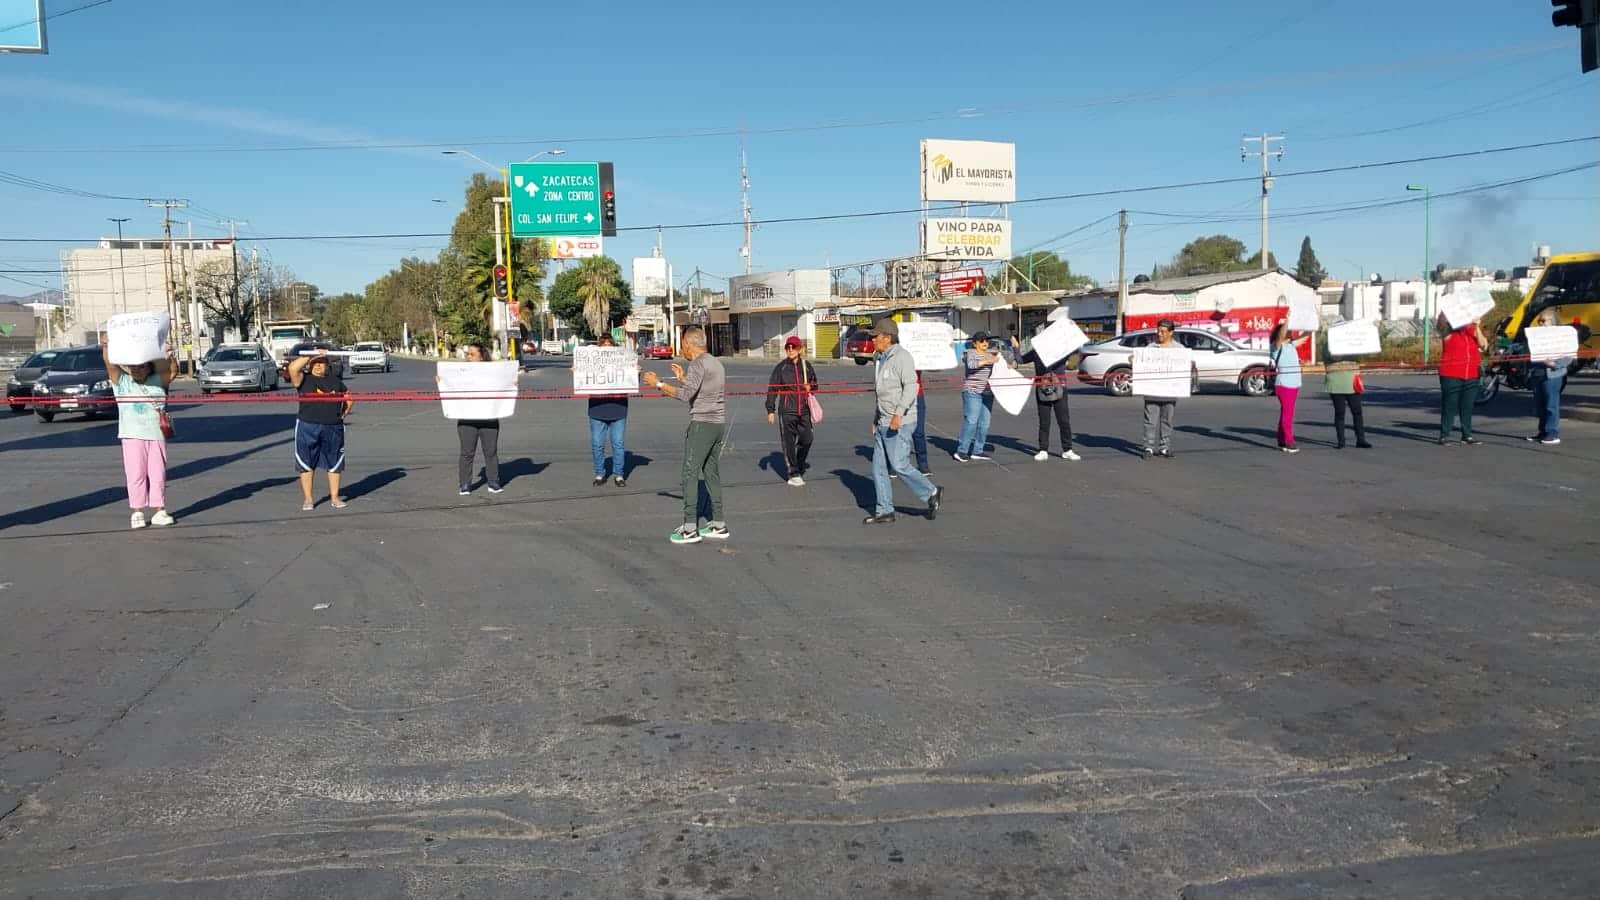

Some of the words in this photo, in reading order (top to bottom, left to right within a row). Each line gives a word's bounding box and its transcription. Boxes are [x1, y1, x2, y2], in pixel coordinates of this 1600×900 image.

[955, 168, 965, 178] EL
[967, 168, 1013, 179] MAYORISTA
[542, 176, 595, 186] ZACATECAS
[543, 191, 563, 201] ZONA
[567, 191, 594, 201] CENTRO
[518, 213, 534, 223] COL.
[537, 213, 552, 223] SAN
[555, 213, 579, 223] FELIPE
[936, 221, 968, 232] VINO
[970, 222, 1003, 233] PARA
[937, 234, 1002, 245] CELEBRAR
[945, 246, 961, 256] LA
[964, 246, 994, 257] VIDA
